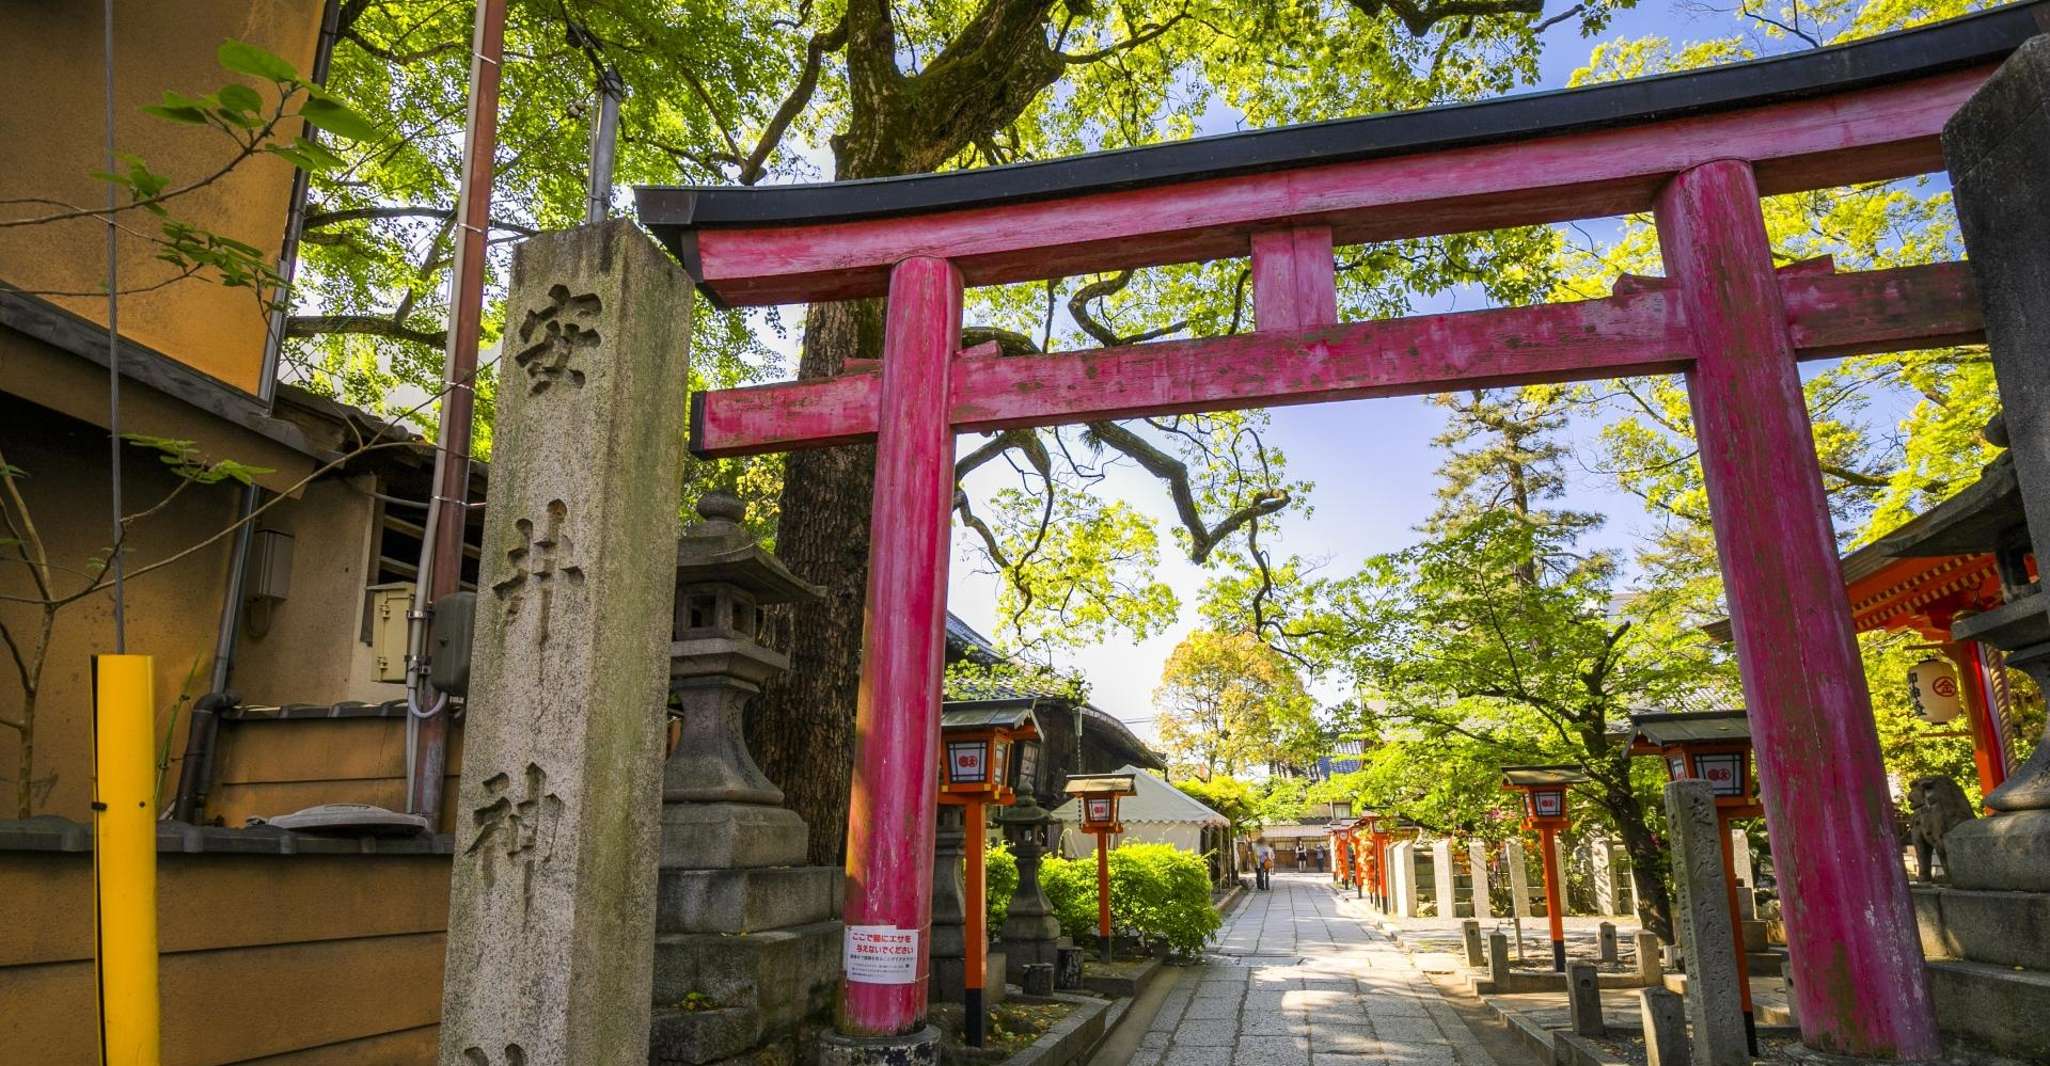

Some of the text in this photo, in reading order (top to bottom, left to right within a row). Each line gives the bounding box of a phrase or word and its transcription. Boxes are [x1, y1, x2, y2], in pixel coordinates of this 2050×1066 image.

[1935, 677, 1954, 694] 金
[856, 944, 913, 954] 与えないでください
